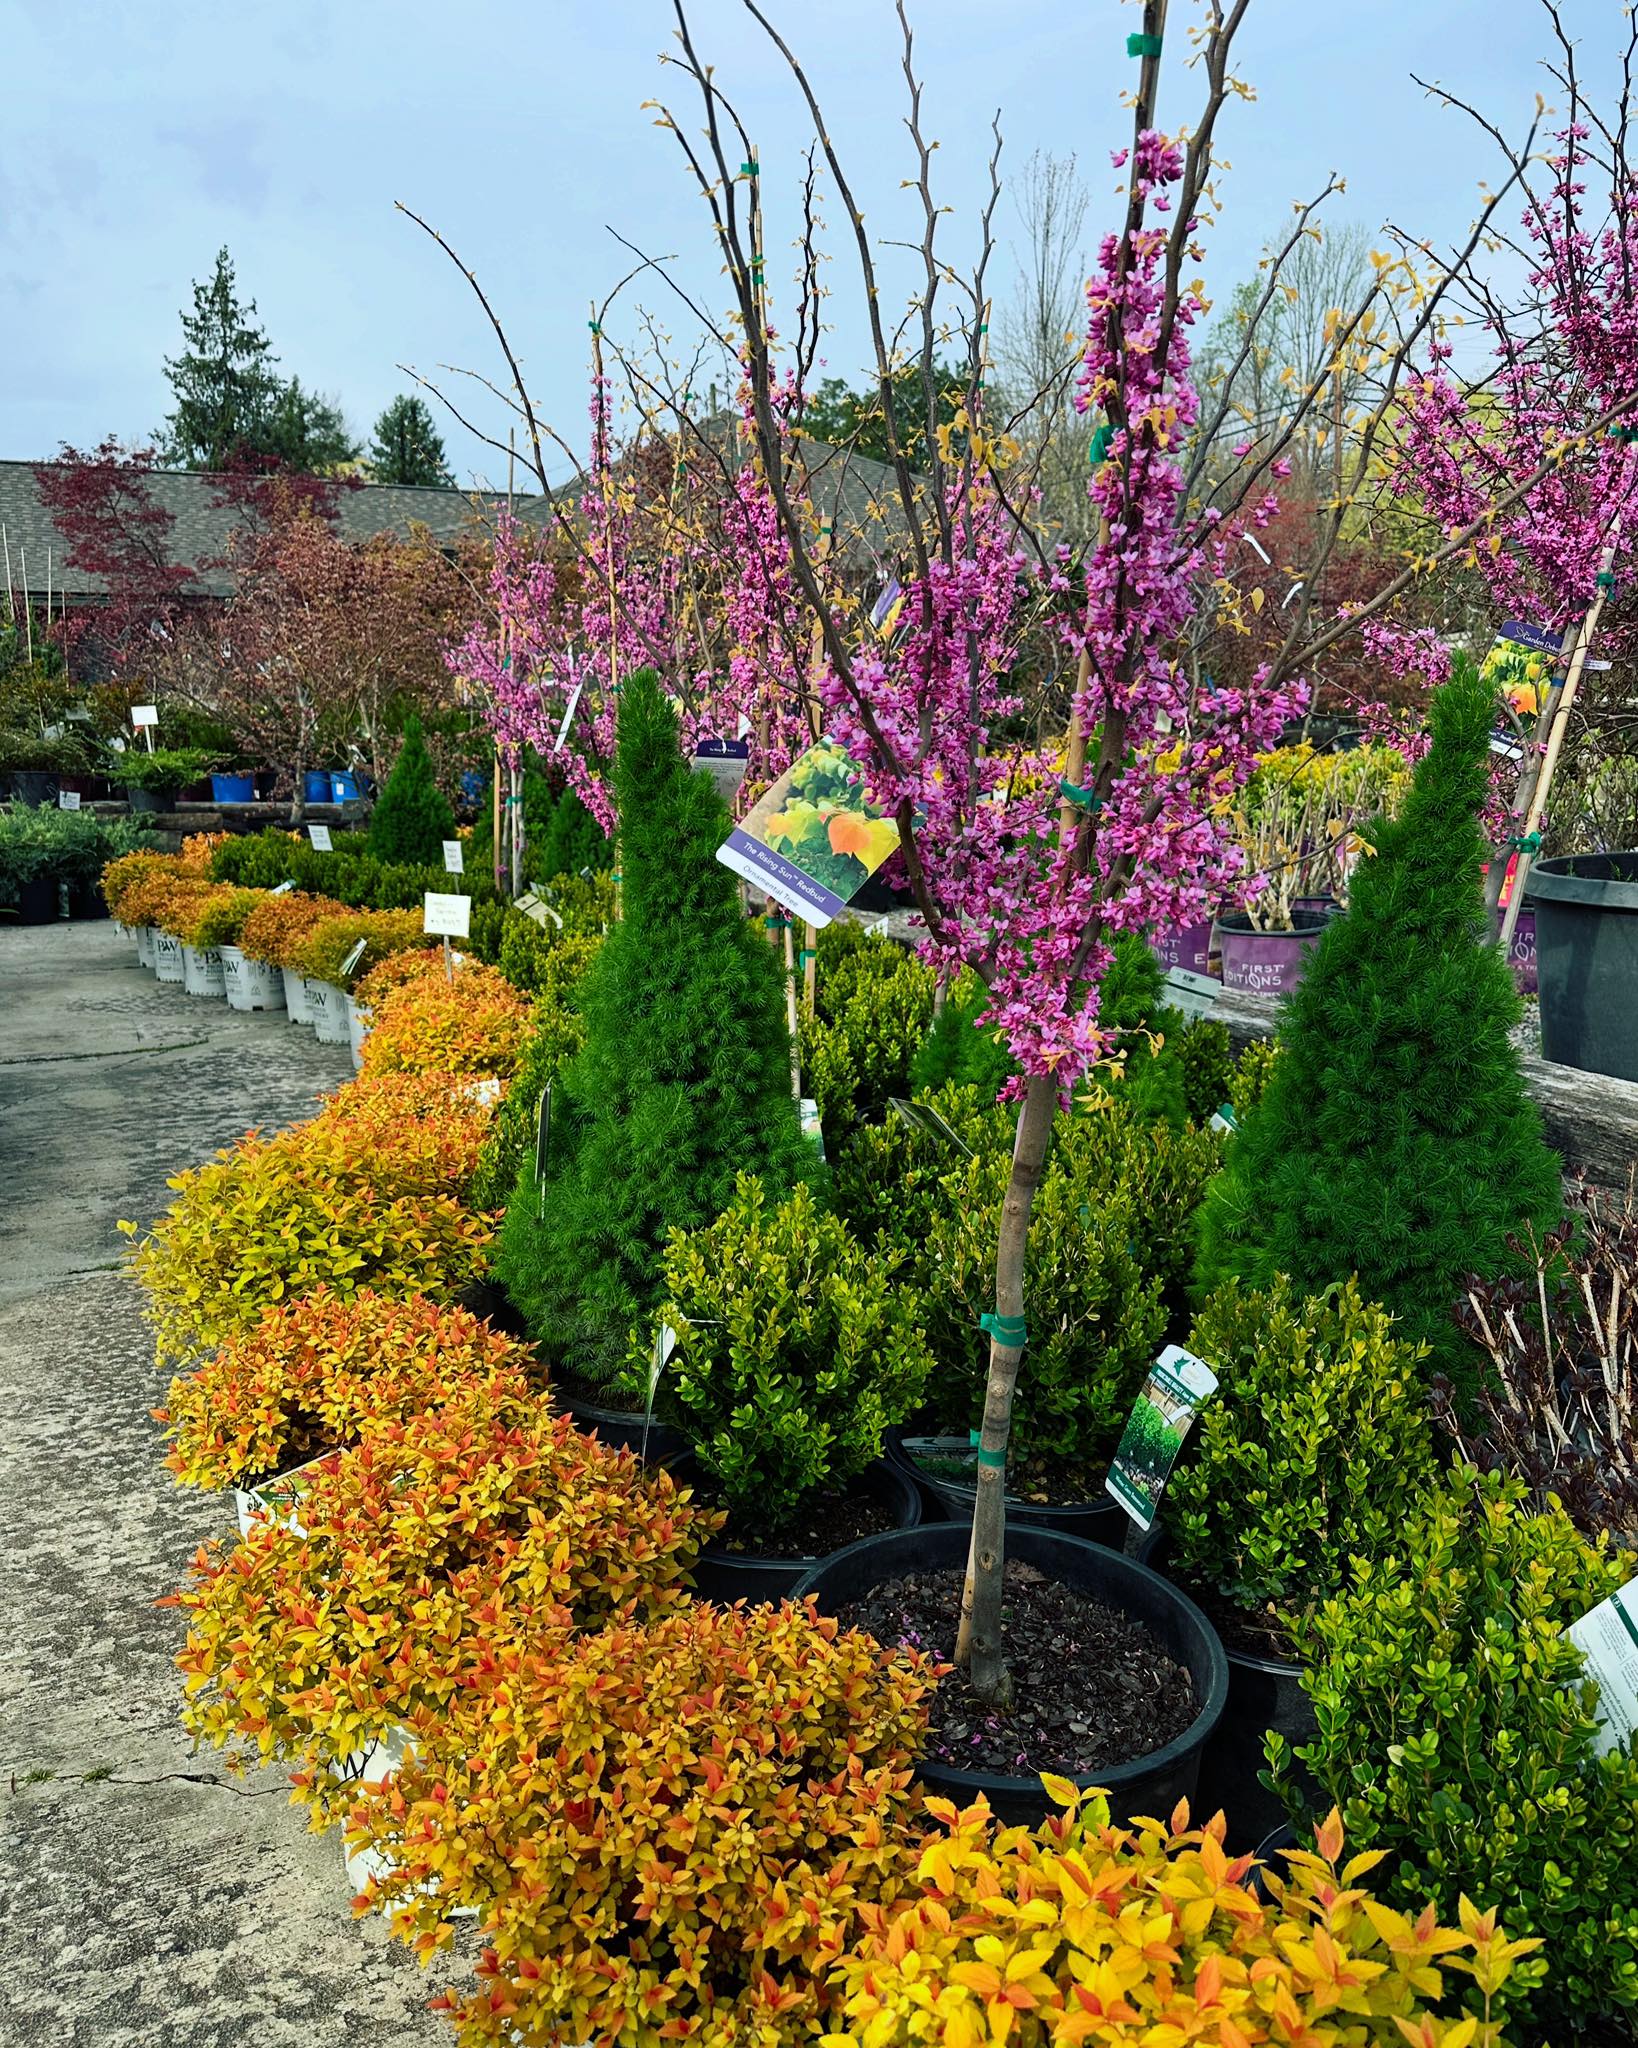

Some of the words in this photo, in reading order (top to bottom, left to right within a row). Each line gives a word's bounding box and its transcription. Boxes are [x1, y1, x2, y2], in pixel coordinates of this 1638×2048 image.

[1523, 634, 1544, 646] Garden
[743, 865, 783, 895] Ornamental
[784, 893, 798, 907] Tree
[744, 842, 757, 854] The
[757, 851, 778, 870] Rising
[796, 880, 826, 903] Redbud
[1224, 969, 1281, 989] EDITIONS
